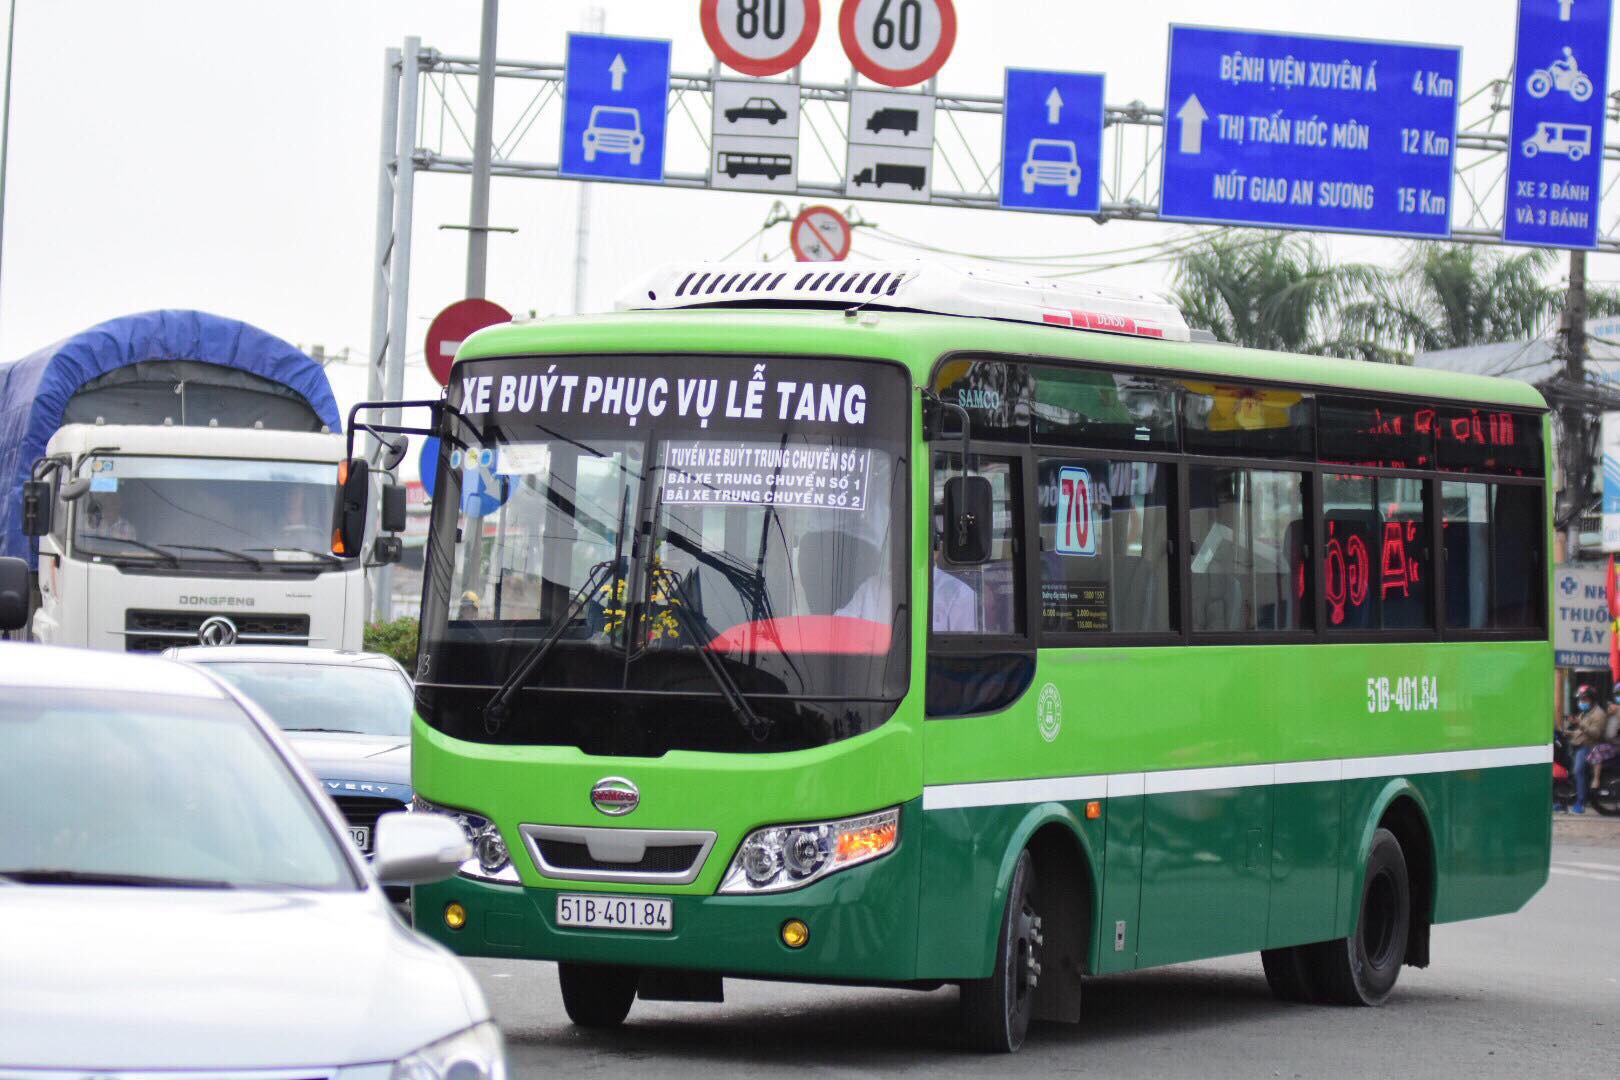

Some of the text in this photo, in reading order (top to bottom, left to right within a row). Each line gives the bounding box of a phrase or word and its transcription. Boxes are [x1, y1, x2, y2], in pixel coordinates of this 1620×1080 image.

[736, 0, 786, 40] 80
[872, 0, 921, 50] 60
[1220, 51, 1264, 86] BỆNH
[1308, 59, 1363, 91] XUYÊN
[1365, 60, 1378, 91] Á
[1412, 70, 1424, 97] 4
[1427, 71, 1454, 97] Km
[1218, 109, 1450, 156] THỊ TRẤN HÓC MÔN 12 Km
[1213, 169, 1446, 216] NÚT GIAO AN SƯƠNG 15 Km
[1517, 180, 1590, 202] XE 2 BÁNH
[1516, 203, 1589, 229] VÀ 3 BÁNH
[459, 363, 868, 429] XE BUÝT PHỤC VỤ LỄ TANG
[958, 388, 1001, 411] SAMCO
[671, 441, 865, 473] TUYẾN XE BUÝT TRUNG CHUYỂN SỐ 1
[668, 470, 860, 491] BÃI XE TRUNG CHUYỂN SỐ 1
[666, 487, 861, 507] BÃI XE TRUNG CHUYỂN SỐ 2
[1061, 478, 1089, 549] 70
[179, 595, 255, 606] DONGFENG
[1585, 585, 1608, 599] NH
[1571, 626, 1606, 644] TÂY
[1367, 675, 1439, 714] 51B-401.84
[561, 899, 667, 926] 51B-401.84
